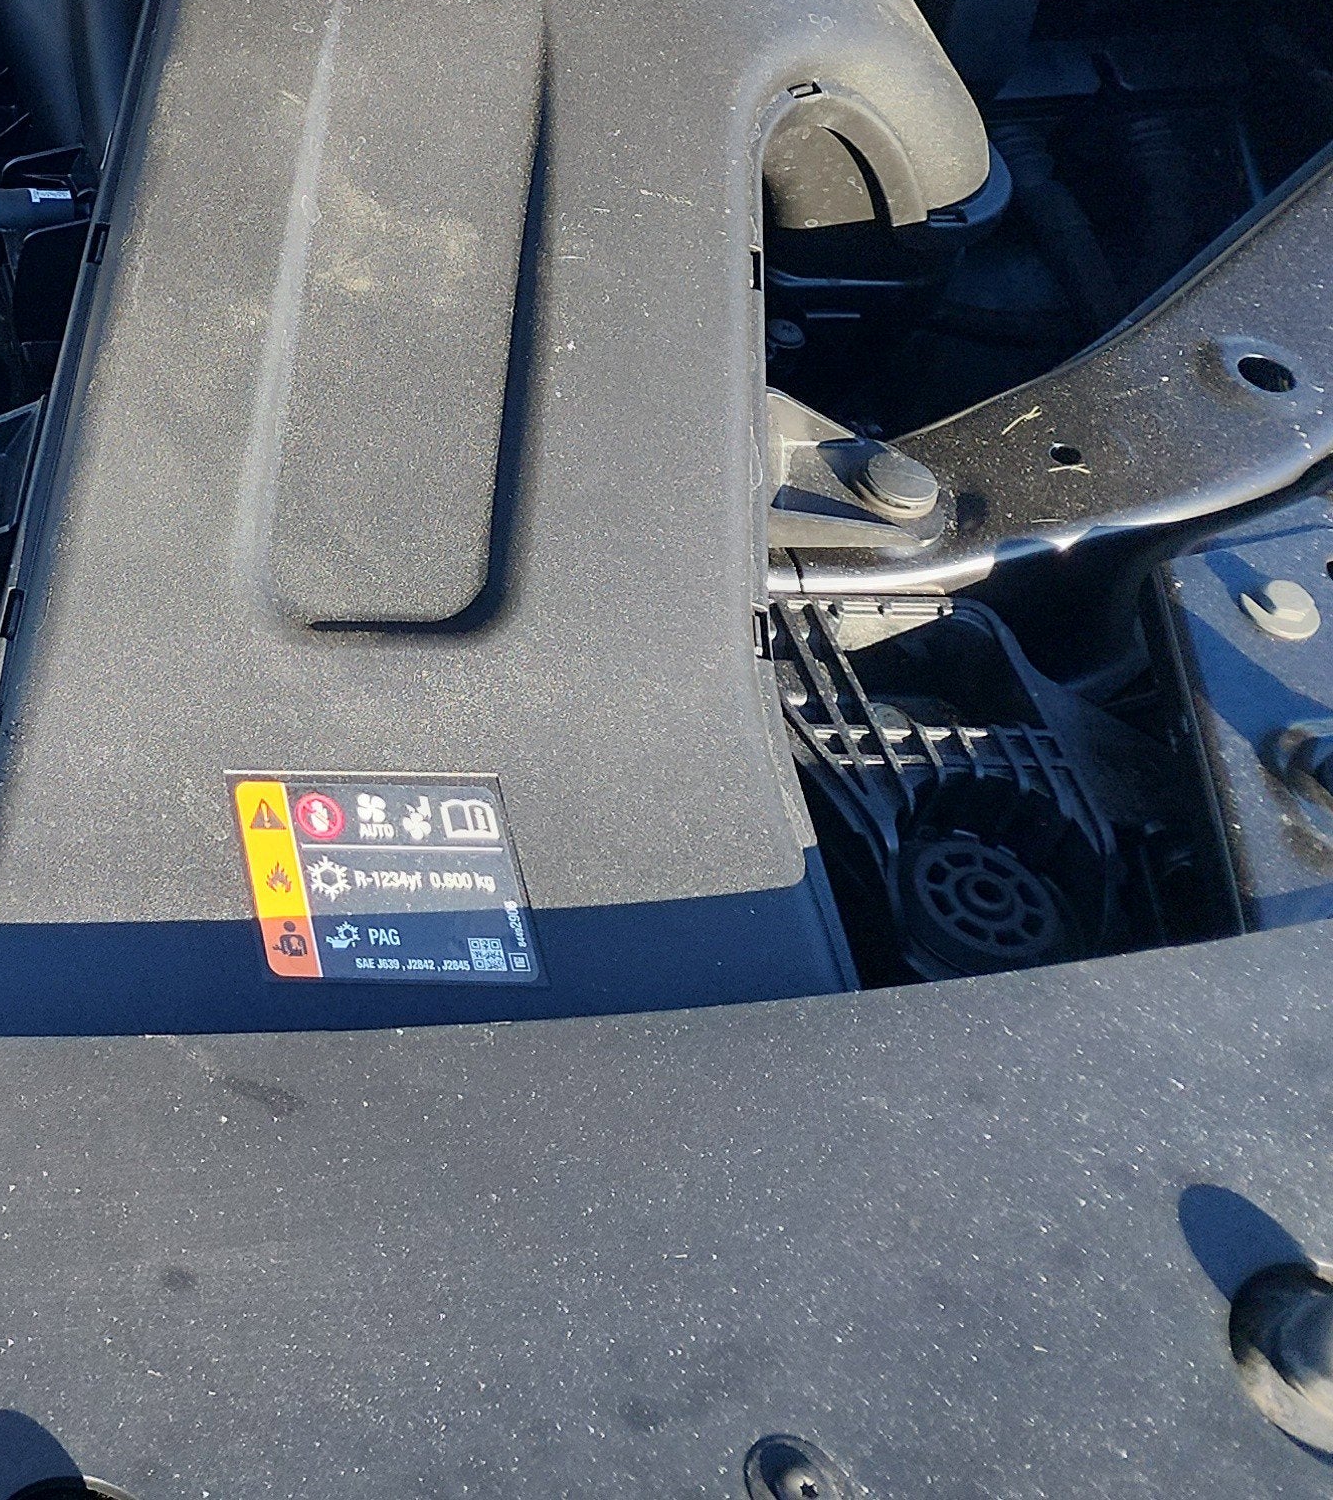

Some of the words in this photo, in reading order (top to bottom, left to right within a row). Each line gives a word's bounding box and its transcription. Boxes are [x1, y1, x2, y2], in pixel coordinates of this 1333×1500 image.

[359, 823, 395, 839] AUTO
[353, 869, 423, 892] R-1234yf
[429, 871, 473, 889] 0.600
[474, 872, 497, 893] kg
[367, 927, 402, 946] PAG
[355, 957, 376, 969] SAE
